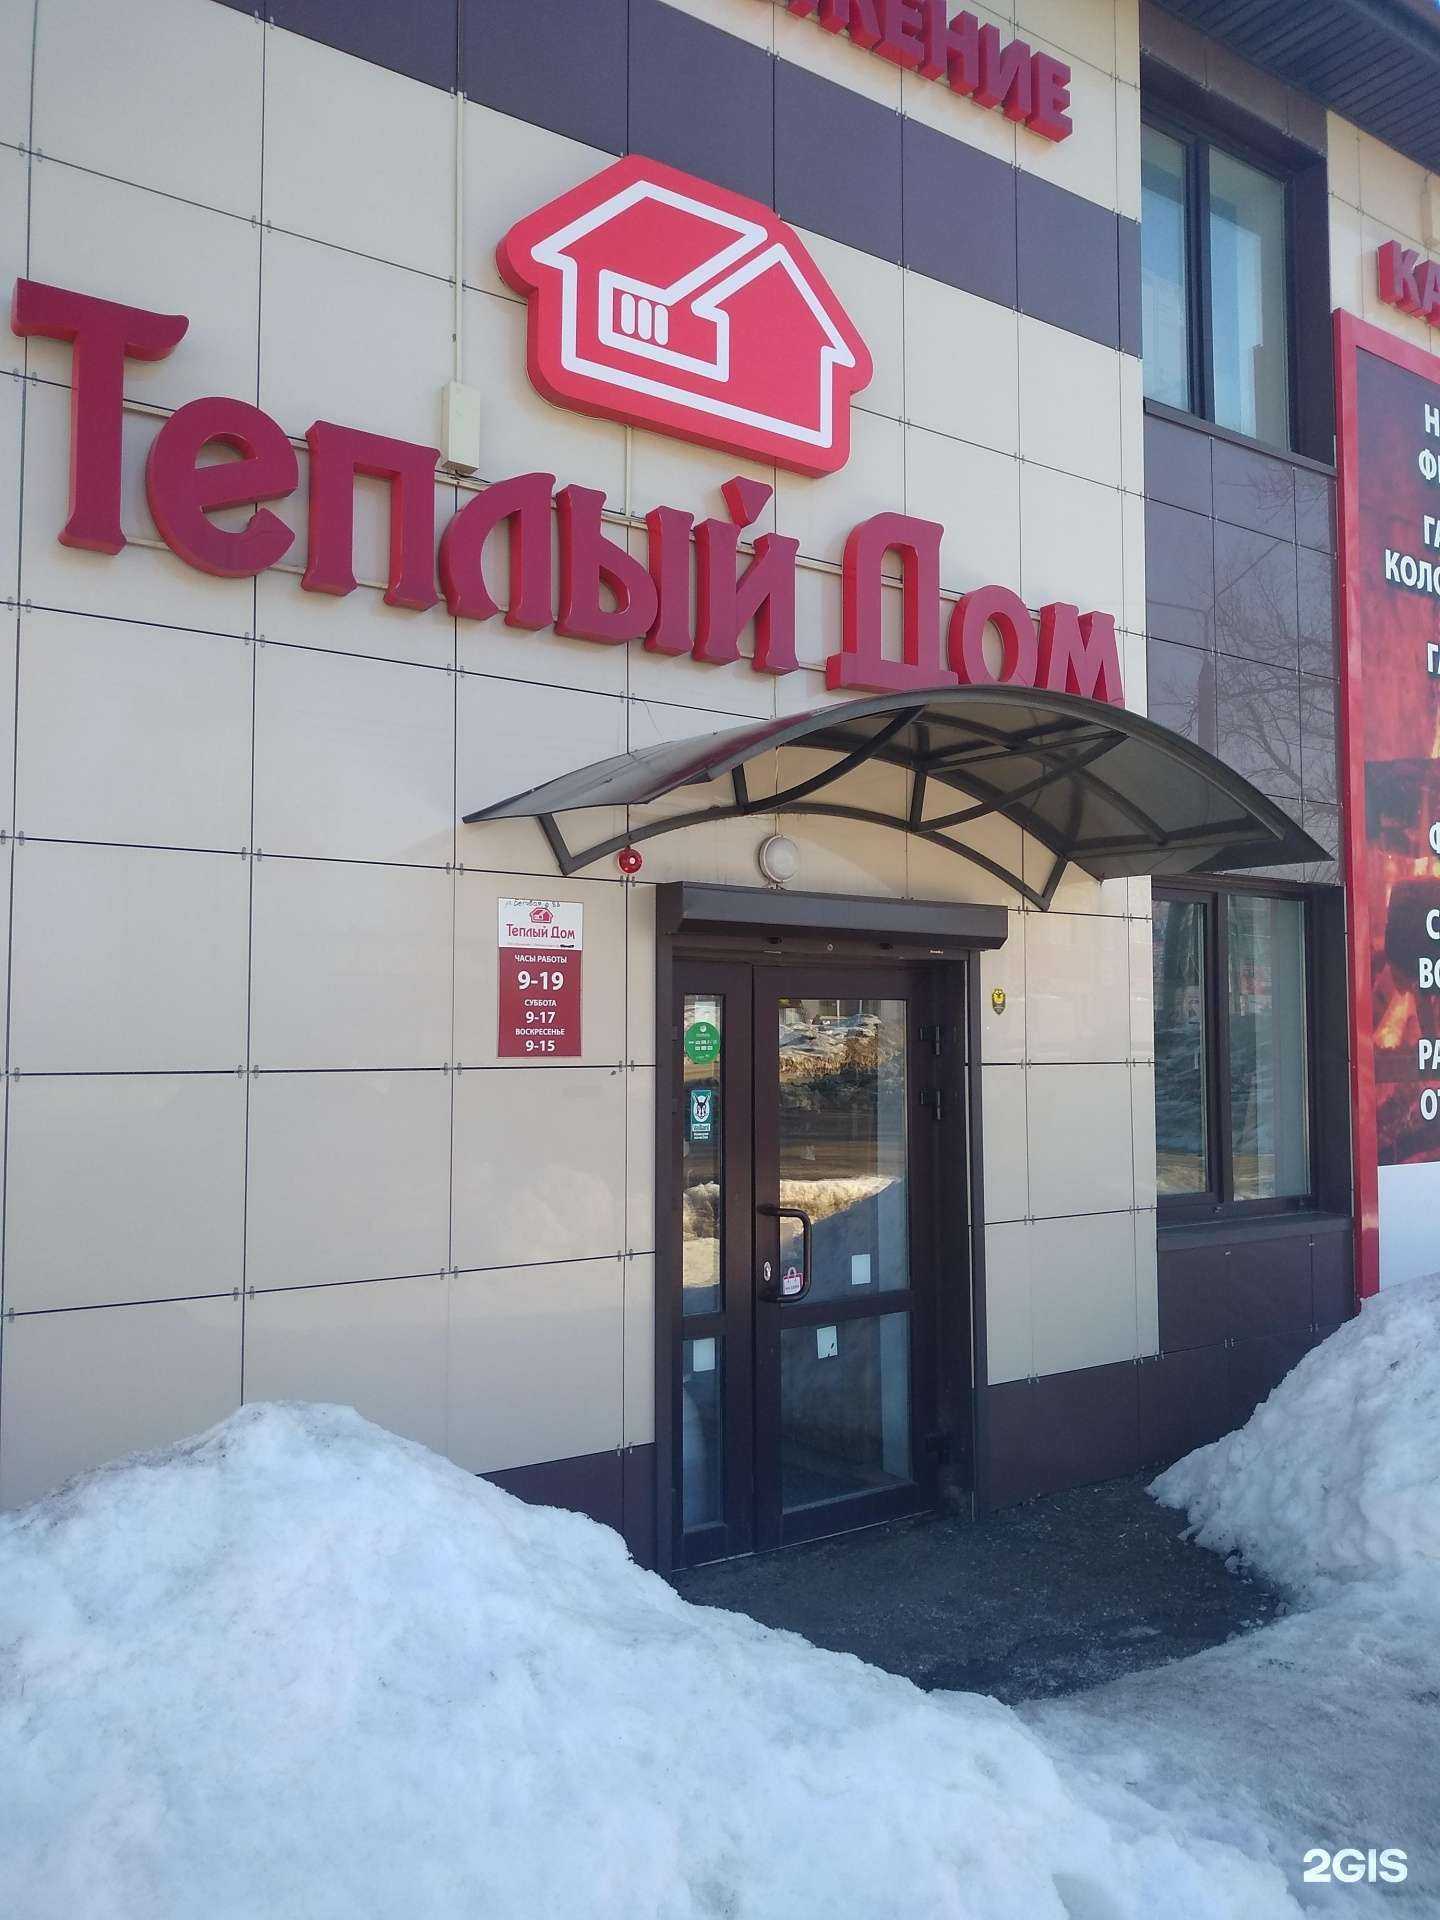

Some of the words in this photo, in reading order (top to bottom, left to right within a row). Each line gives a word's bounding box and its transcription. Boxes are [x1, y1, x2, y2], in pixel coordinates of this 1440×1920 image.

[11, 277, 800, 676] Теплый
[826, 511, 1126, 709] Дом
[506, 923, 549, 939] Теплый
[551, 926, 576, 940] Дом
[514, 954, 536, 963] ЧАСЫ
[537, 955, 568, 964] РАБОТЫ
[517, 970, 564, 991] 9-19
[524, 999, 557, 1007] СУББОТА
[525, 1011, 556, 1024] 9-17
[515, 1028, 566, 1036] ВОСКРЕСЕНЬЕ
[525, 1039, 556, 1052] 9-15
